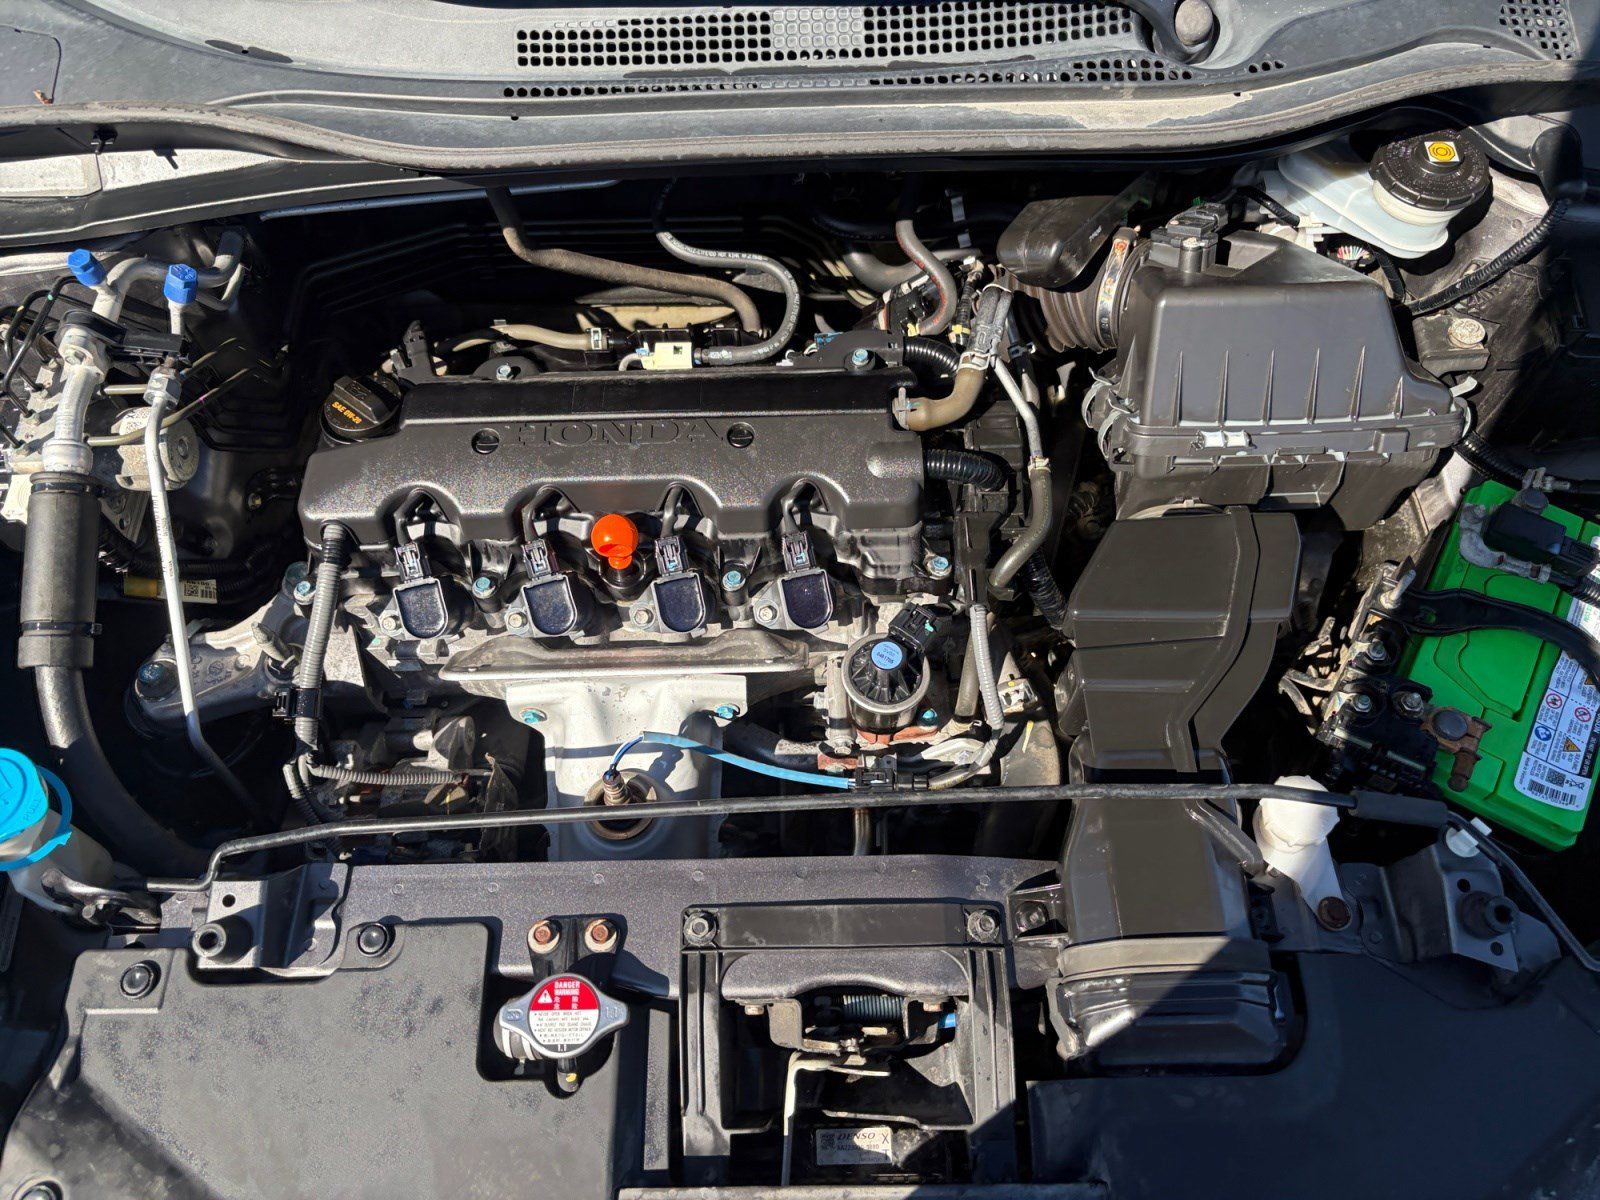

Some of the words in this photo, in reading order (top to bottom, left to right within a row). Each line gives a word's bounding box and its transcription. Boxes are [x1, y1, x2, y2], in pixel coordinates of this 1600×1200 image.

[332, 401, 347, 412] SAE
[503, 419, 724, 447] HONDA
[554, 981, 580, 989] DANGER
